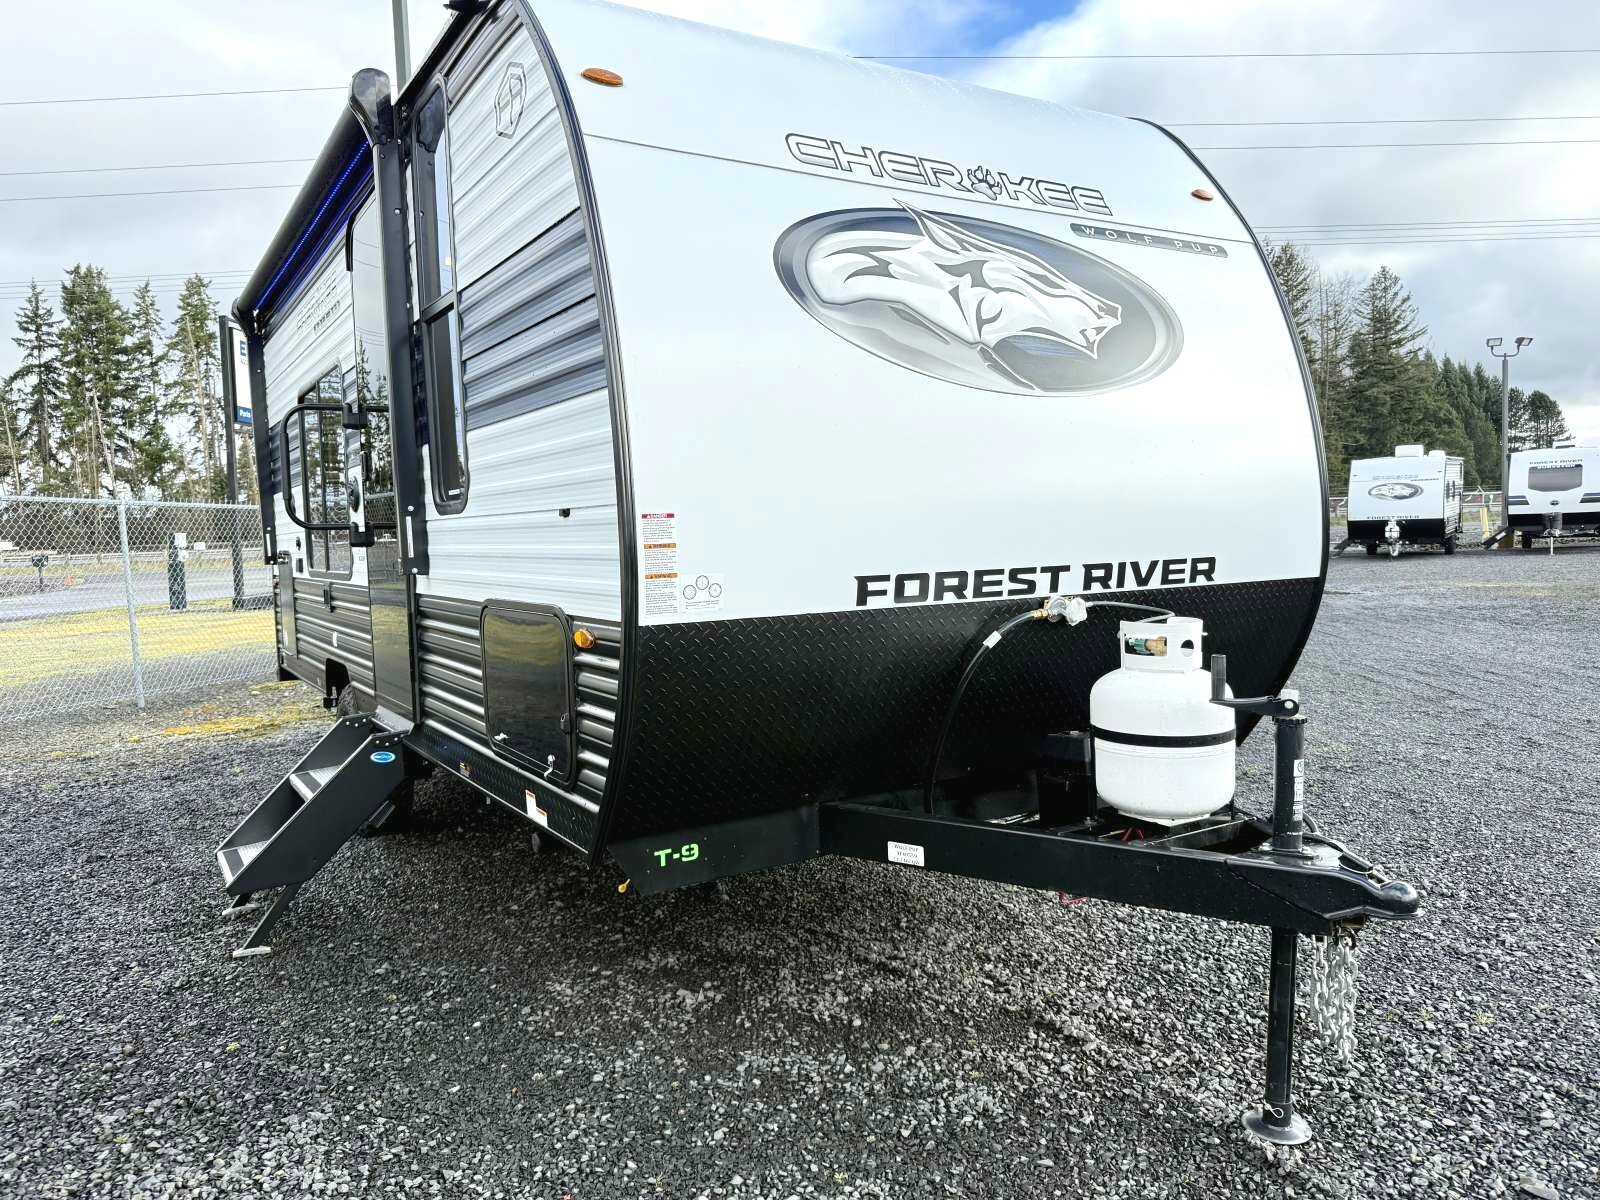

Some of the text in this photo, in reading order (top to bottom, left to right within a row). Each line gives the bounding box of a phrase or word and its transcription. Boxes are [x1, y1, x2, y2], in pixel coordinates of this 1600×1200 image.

[1081, 225, 1219, 255] WOLF PUP
[854, 556, 1216, 607] FOREST RIVER
[653, 843, 699, 867] T-9
